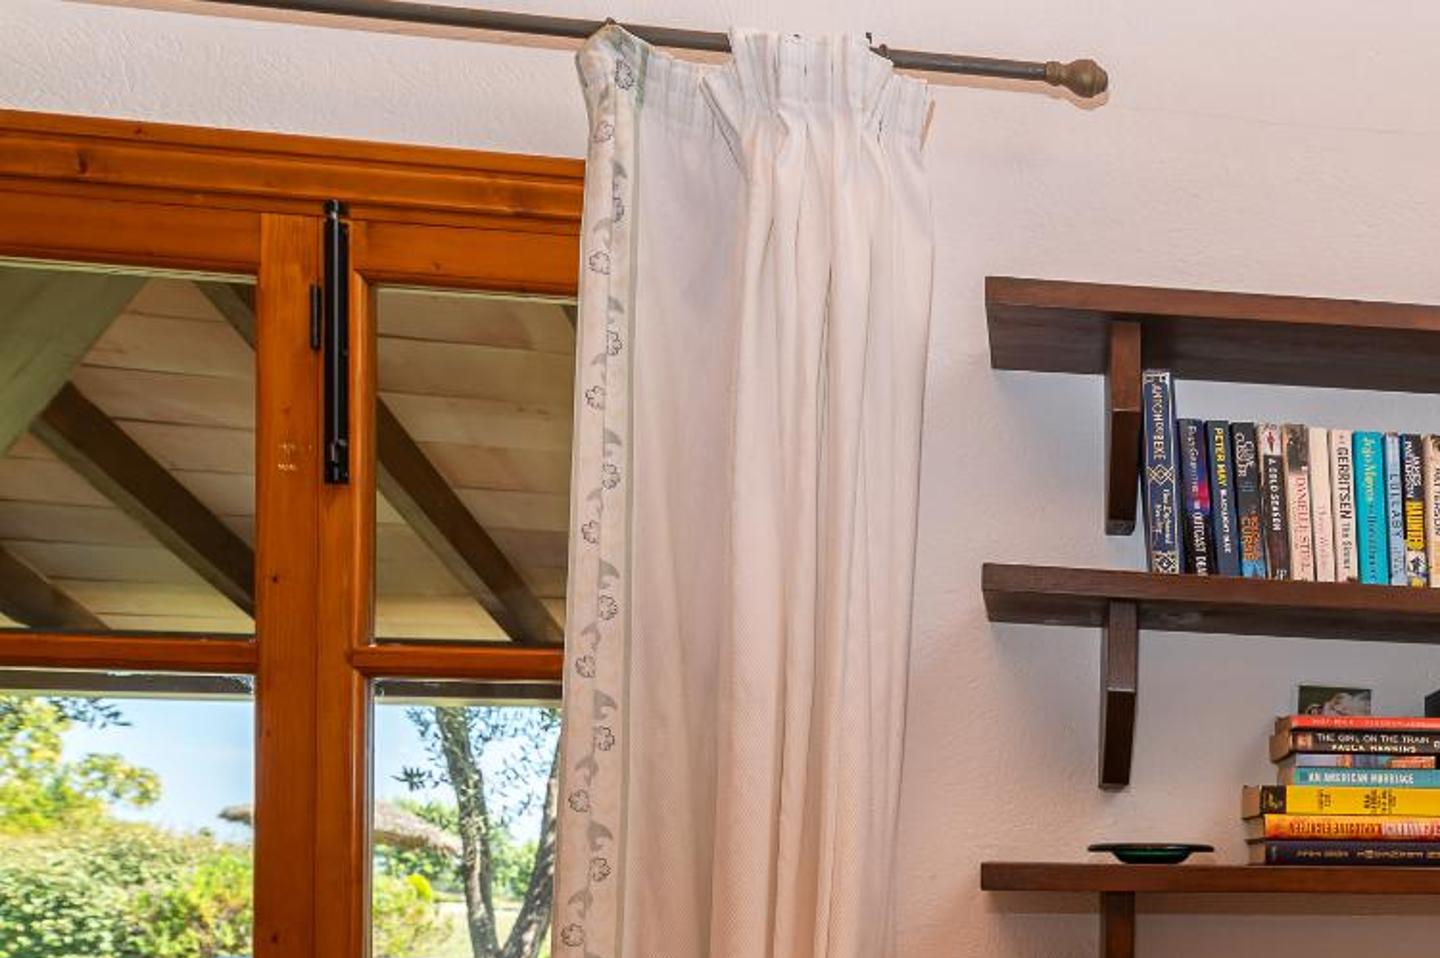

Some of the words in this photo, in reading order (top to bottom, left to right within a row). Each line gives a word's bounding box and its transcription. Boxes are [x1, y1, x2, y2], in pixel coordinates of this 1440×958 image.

[1151, 383, 1164, 421] ANTON
[1152, 435, 1166, 461] BEKE
[1214, 427, 1225, 462] PETER
[1216, 464, 1227, 487] MAY
[1337, 447, 1353, 519] GERRITSEN
[1271, 494, 1281, 531] SEASON
[1296, 477, 1308, 531] DANIELLE
[1390, 473, 1402, 538] LULLABY
[1192, 511, 1206, 552] OUTCAST
[1299, 534, 1311, 572] STEEL
[1318, 733, 1335, 743] THE
[1337, 734, 1360, 744] GIRL
[1363, 734, 1378, 744] ON
[1381, 735, 1400, 744] THE
[1402, 735, 1430, 745] TRAIN
[1324, 774, 1369, 784] AMERICAN
[1371, 774, 1414, 784] MARRIAGE
